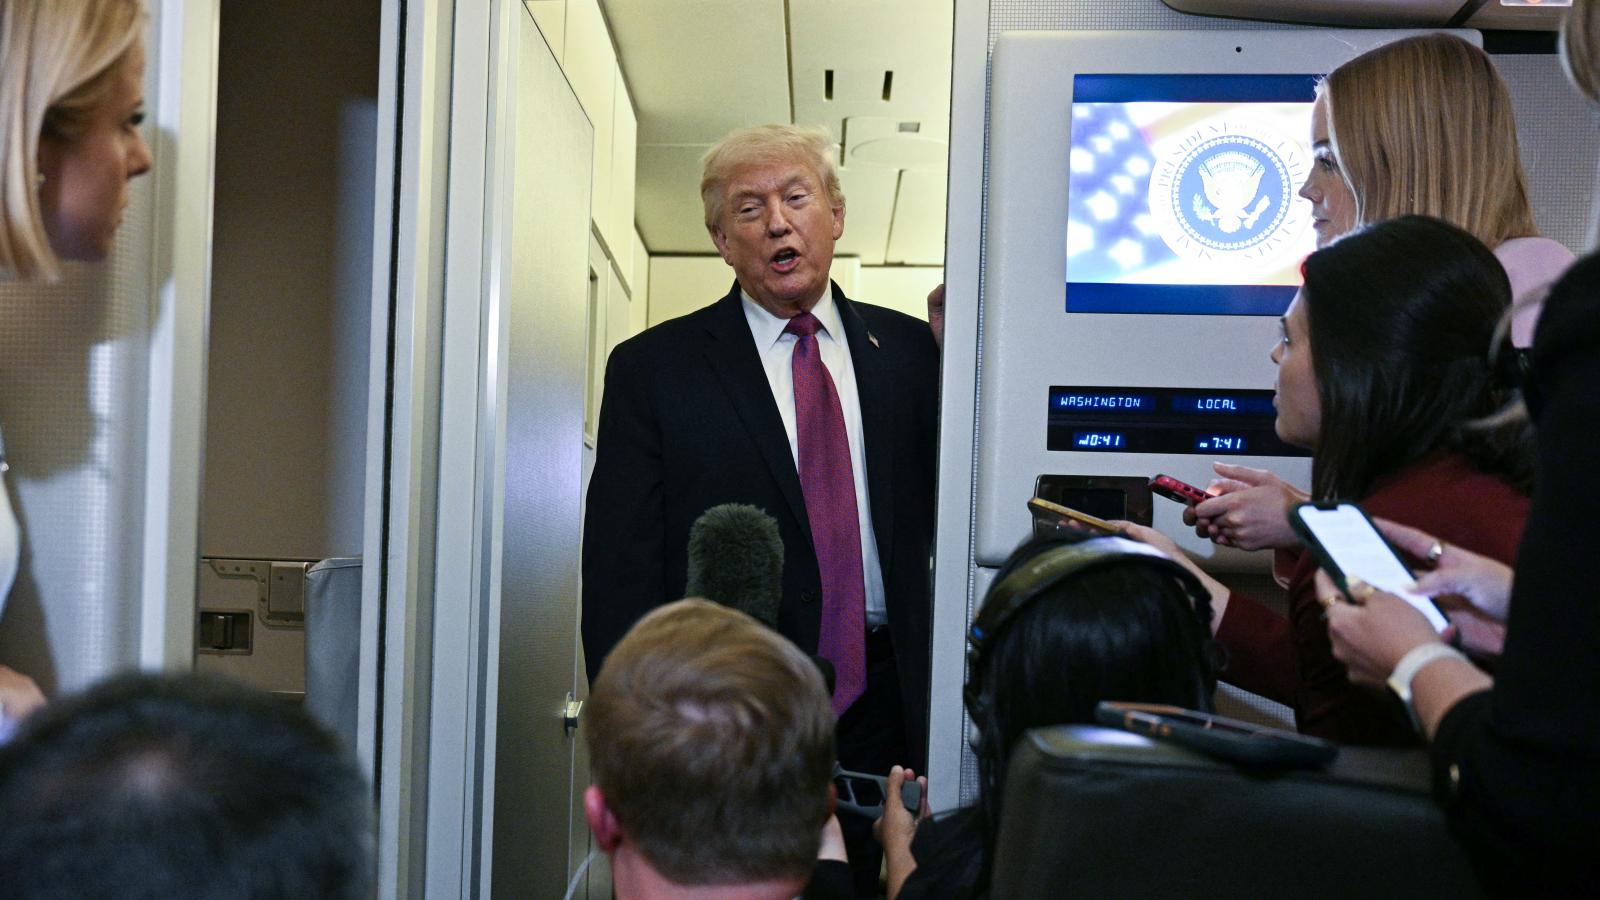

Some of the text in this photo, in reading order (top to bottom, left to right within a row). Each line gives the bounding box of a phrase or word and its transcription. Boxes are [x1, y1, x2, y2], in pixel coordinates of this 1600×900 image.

[1060, 396, 1141, 408] WASHINGTON
[1197, 398, 1237, 410] LOCAL
[1212, 437, 1242, 449] 7:41
